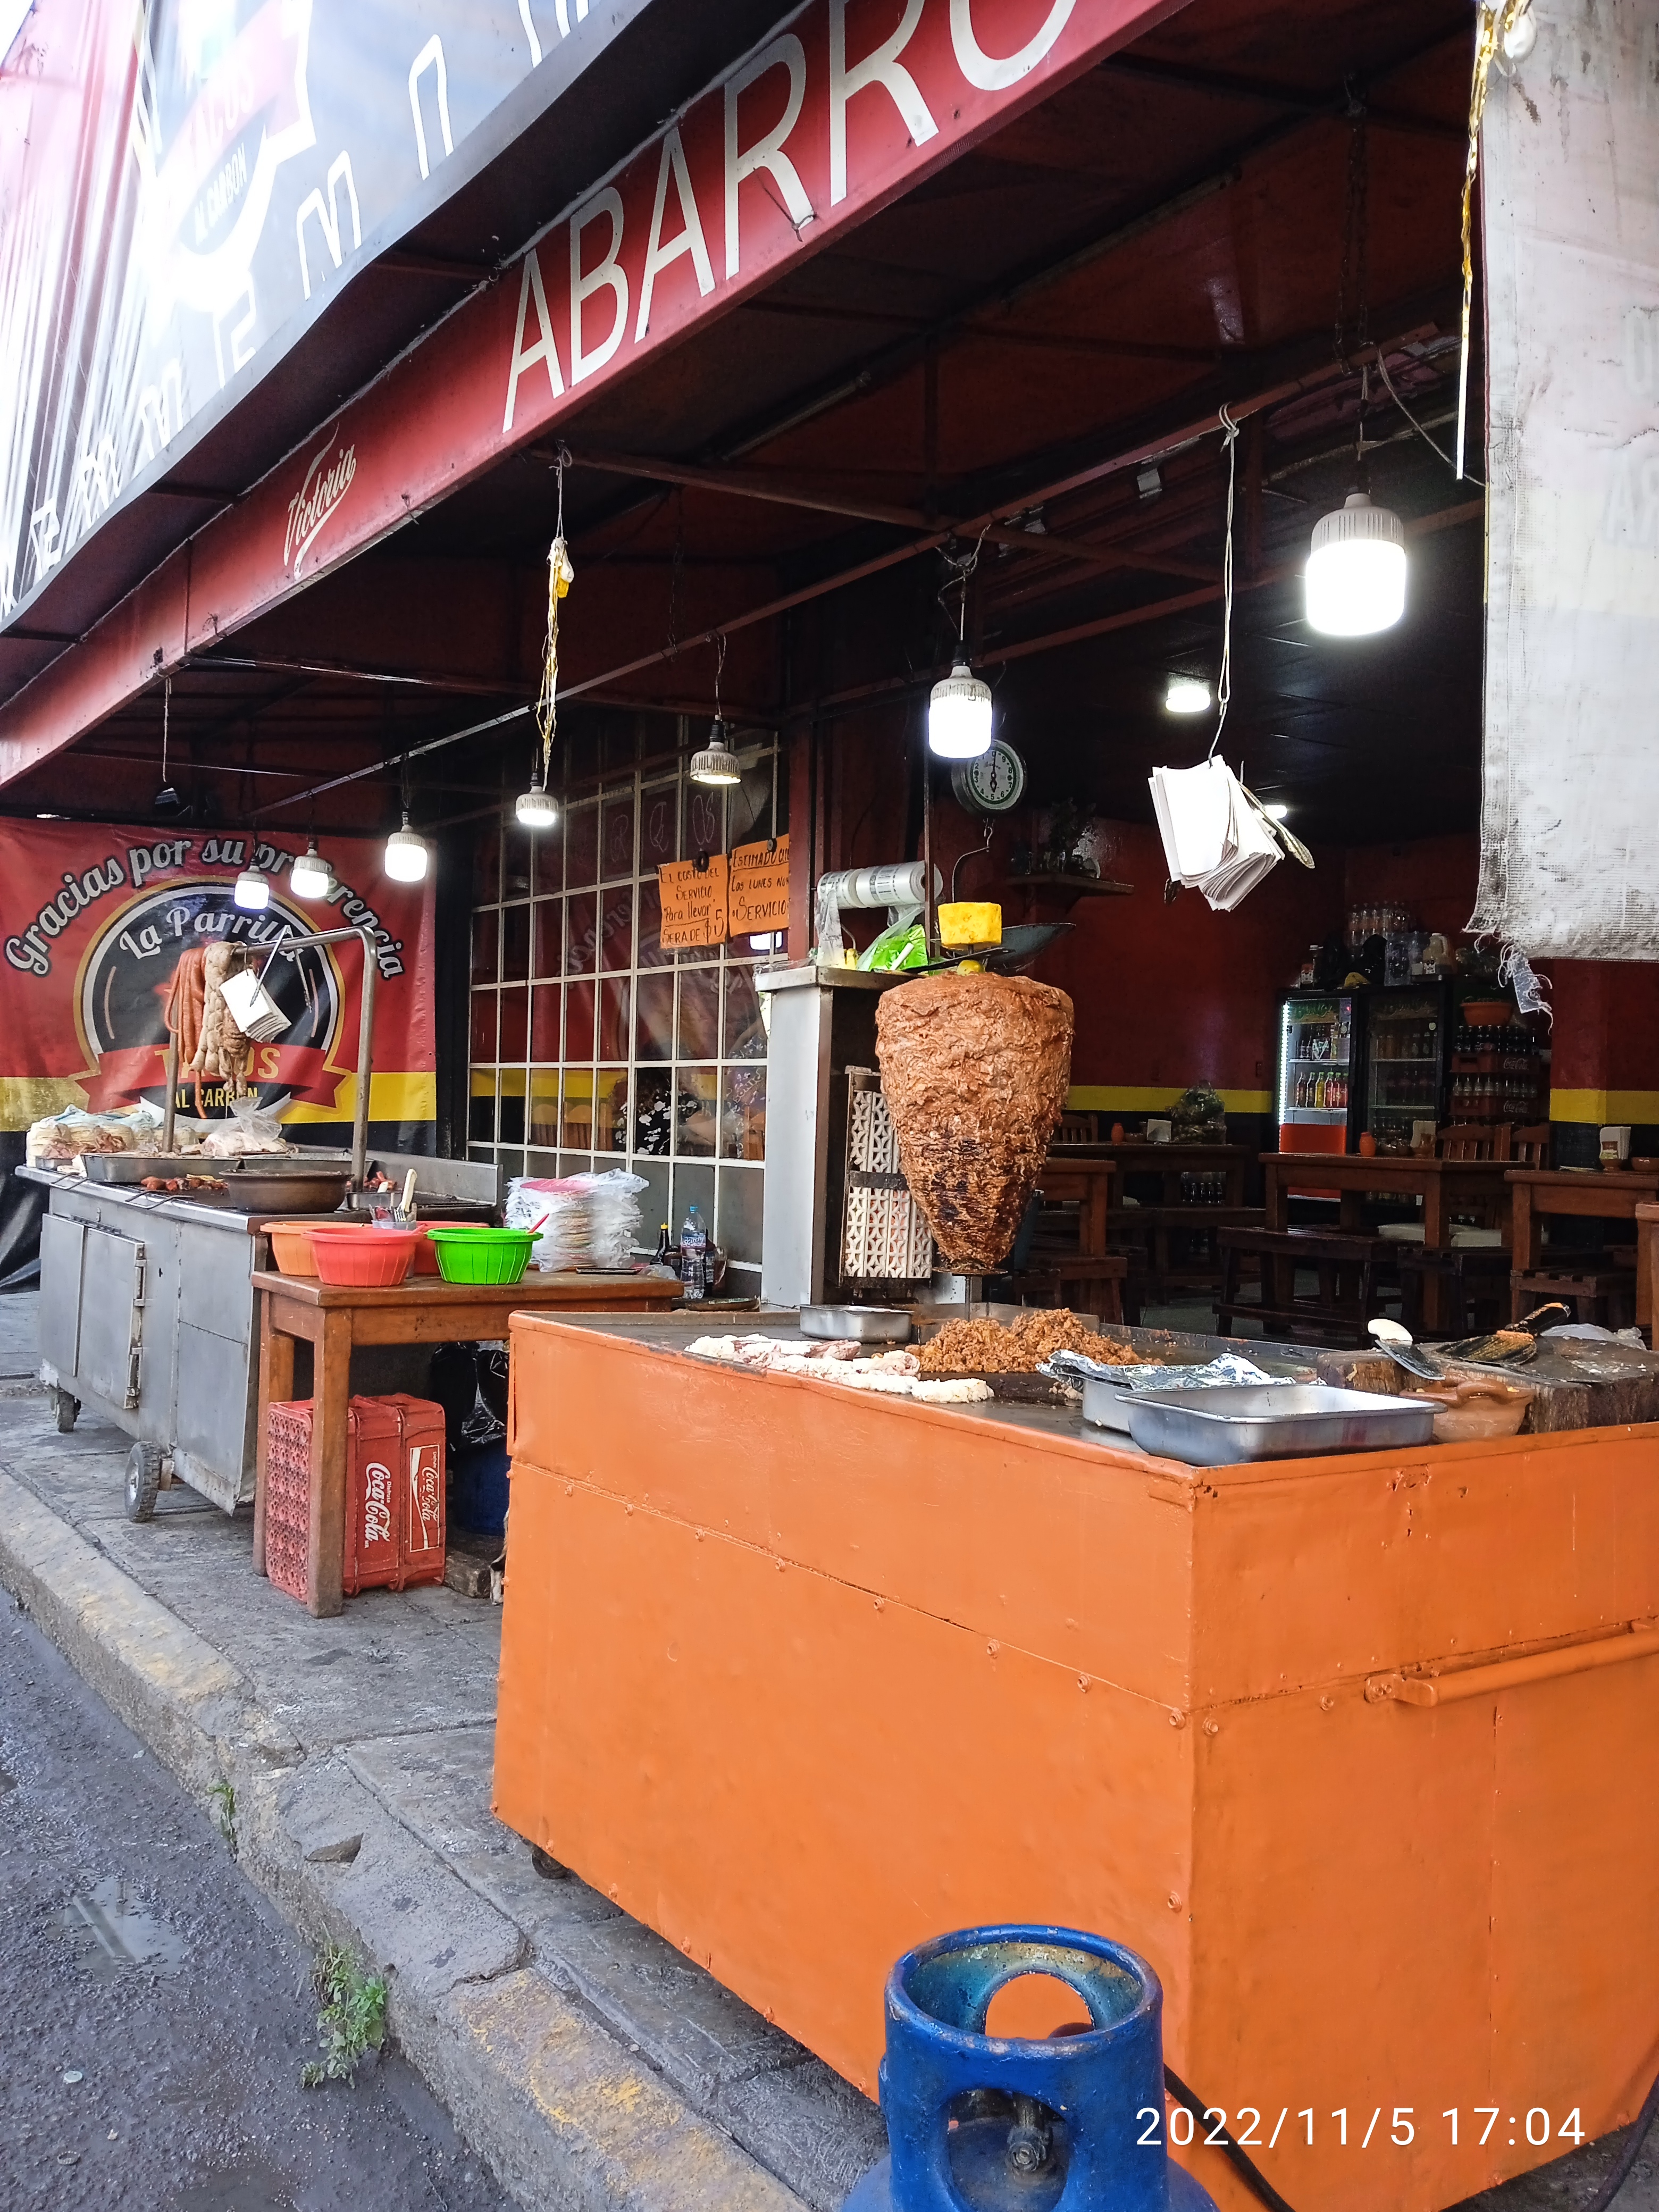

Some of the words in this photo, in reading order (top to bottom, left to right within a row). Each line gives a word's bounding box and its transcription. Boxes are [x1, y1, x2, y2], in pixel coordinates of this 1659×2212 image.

[283, 422, 357, 580] Victoria
[6, 858, 124, 975] Gracias
[129, 840, 191, 886] por
[202, 839, 244, 864] su
[255, 843, 403, 977] prerencia
[120, 925, 162, 959] La
[166, 906, 304, 961] Parril
[676, 885, 712, 901] SERVICIO
